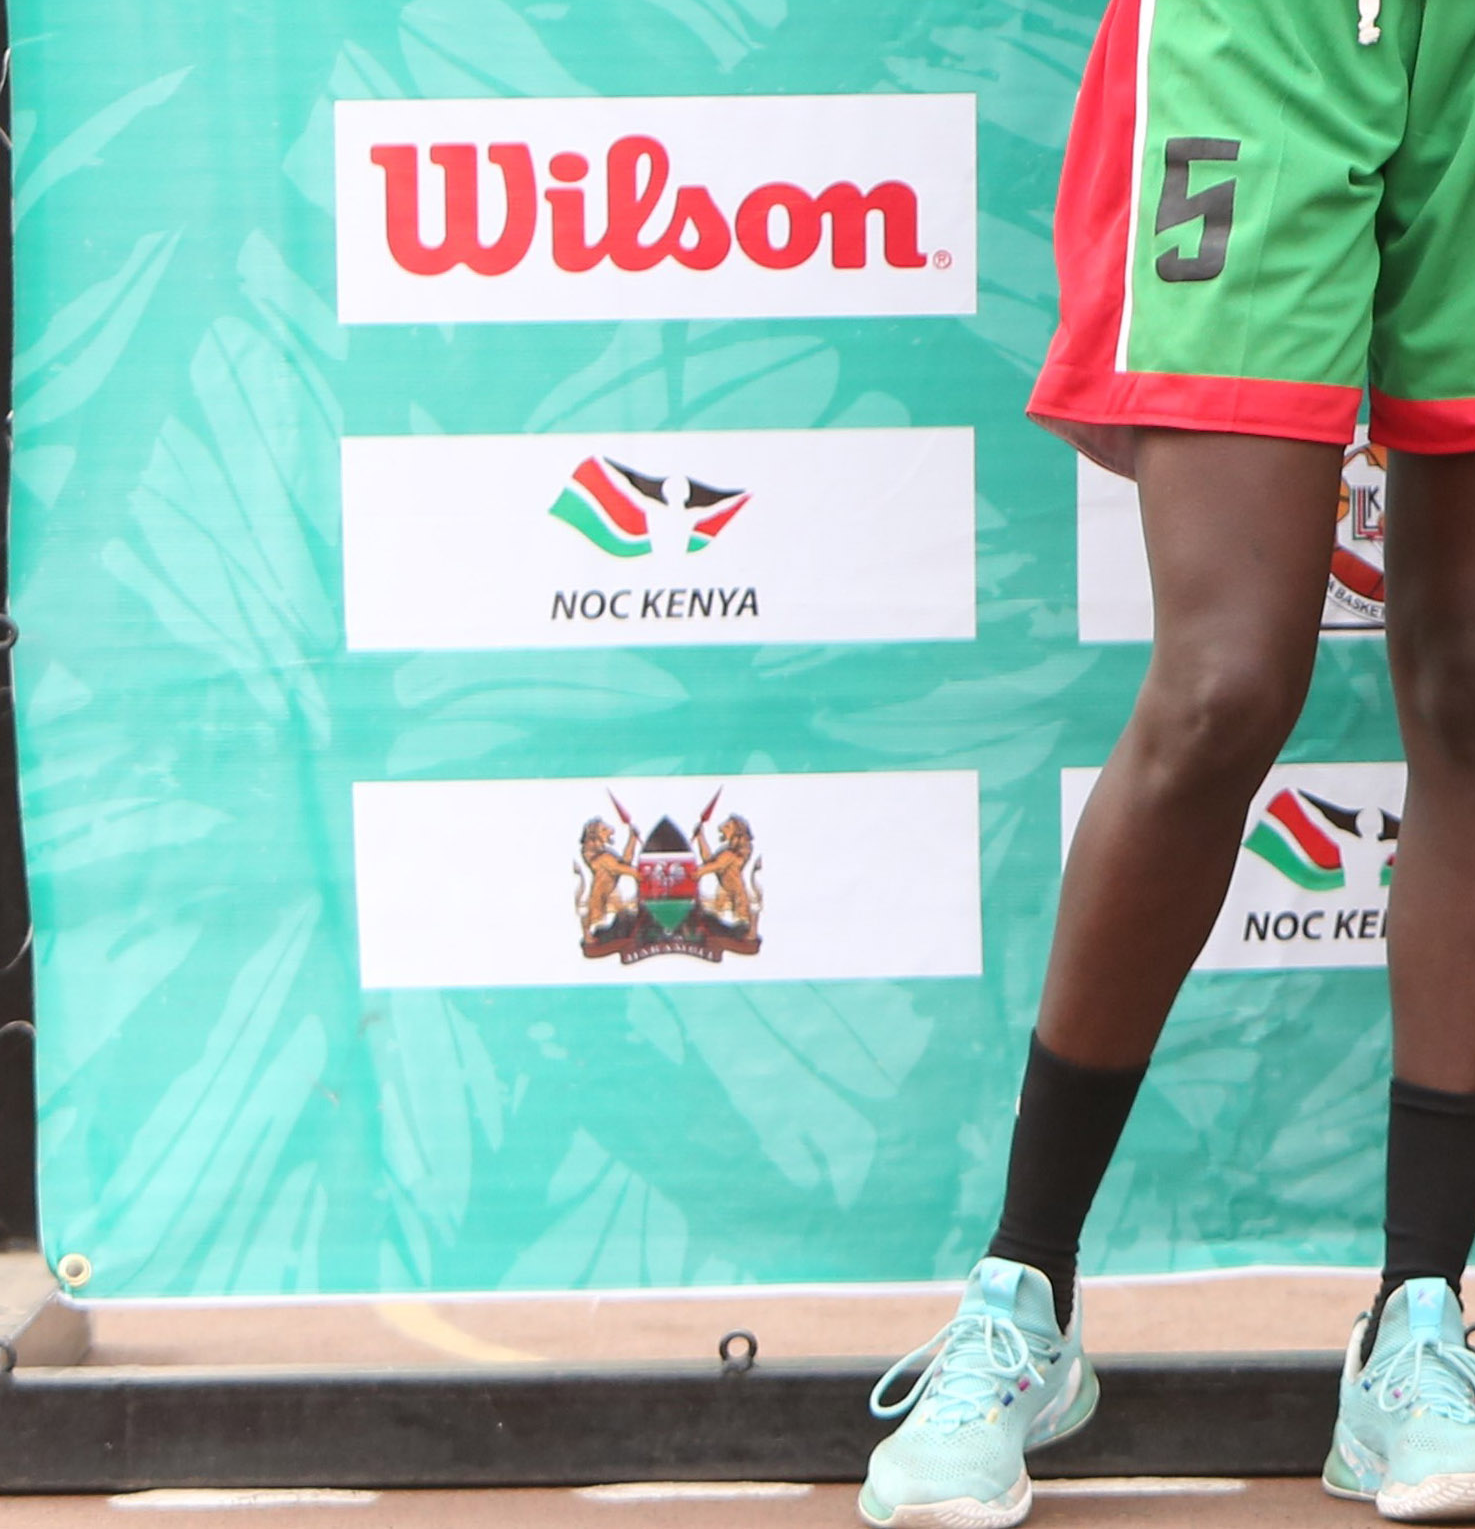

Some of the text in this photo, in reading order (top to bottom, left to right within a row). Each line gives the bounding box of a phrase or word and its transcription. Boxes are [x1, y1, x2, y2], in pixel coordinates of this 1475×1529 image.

[370, 134, 928, 277] Wilson
[1153, 136, 1243, 283] 5
[550, 587, 761, 621] NOC KENYA
[1243, 910, 1326, 942] NOC
